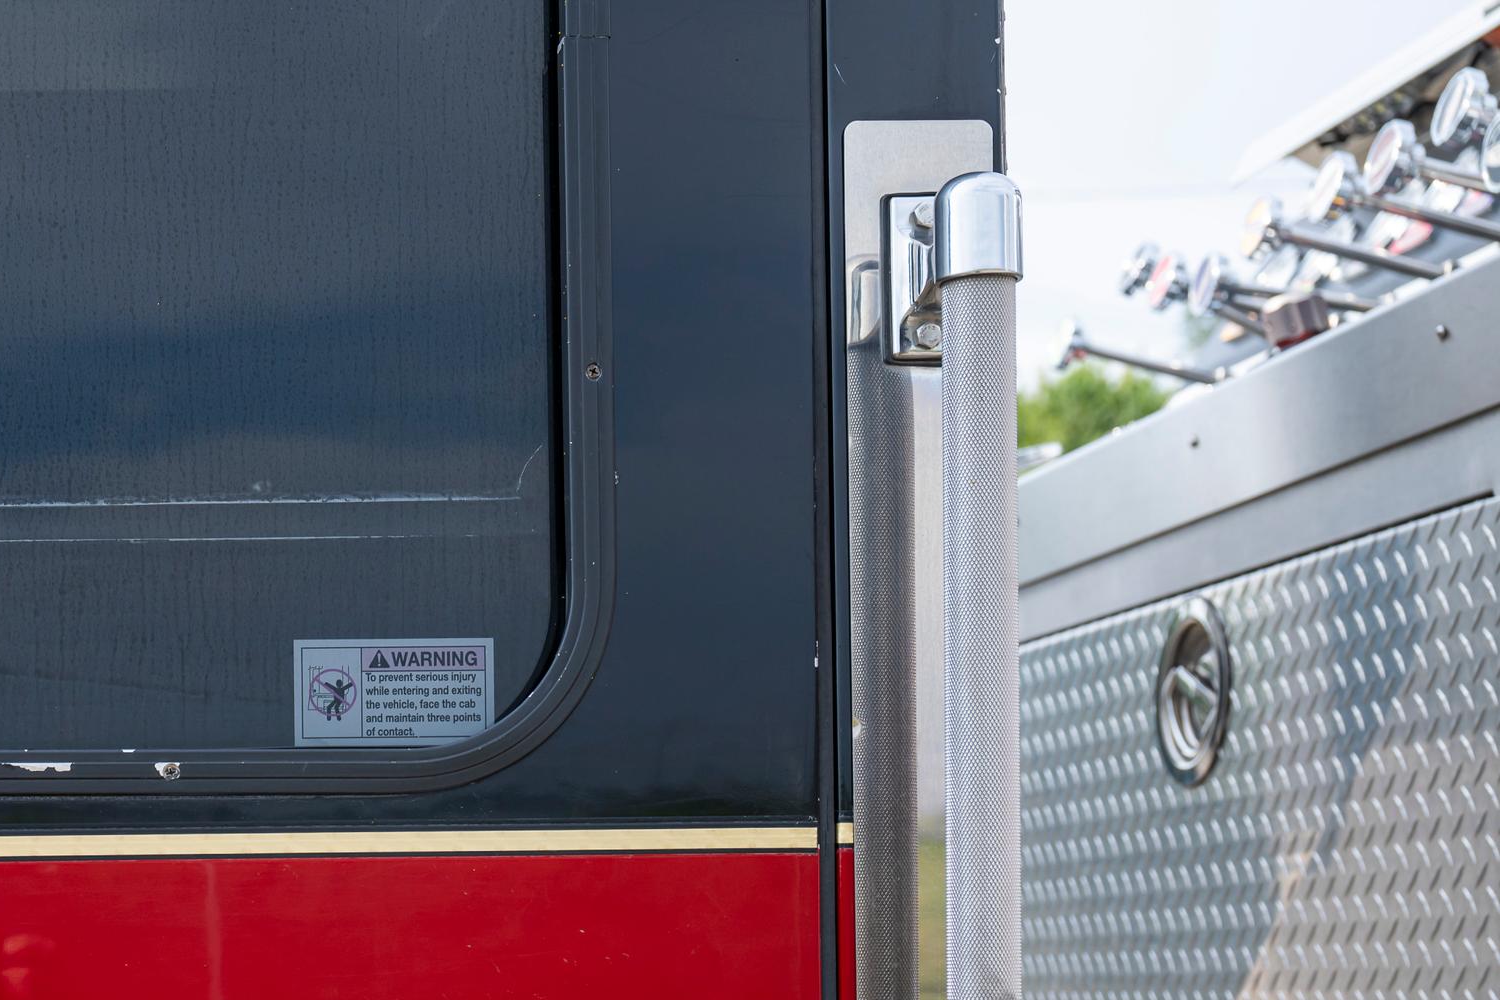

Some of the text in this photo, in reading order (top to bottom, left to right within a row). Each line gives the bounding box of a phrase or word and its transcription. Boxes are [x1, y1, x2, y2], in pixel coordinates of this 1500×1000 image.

[391, 651, 478, 667] WARNING
[365, 672, 476, 684] To prevent serious injury
[365, 686, 482, 697] while entering and exiting
[366, 699, 476, 711] the vehicle, face the cab
[365, 713, 481, 724] and maintain three points
[366, 727, 415, 737] of contact.
